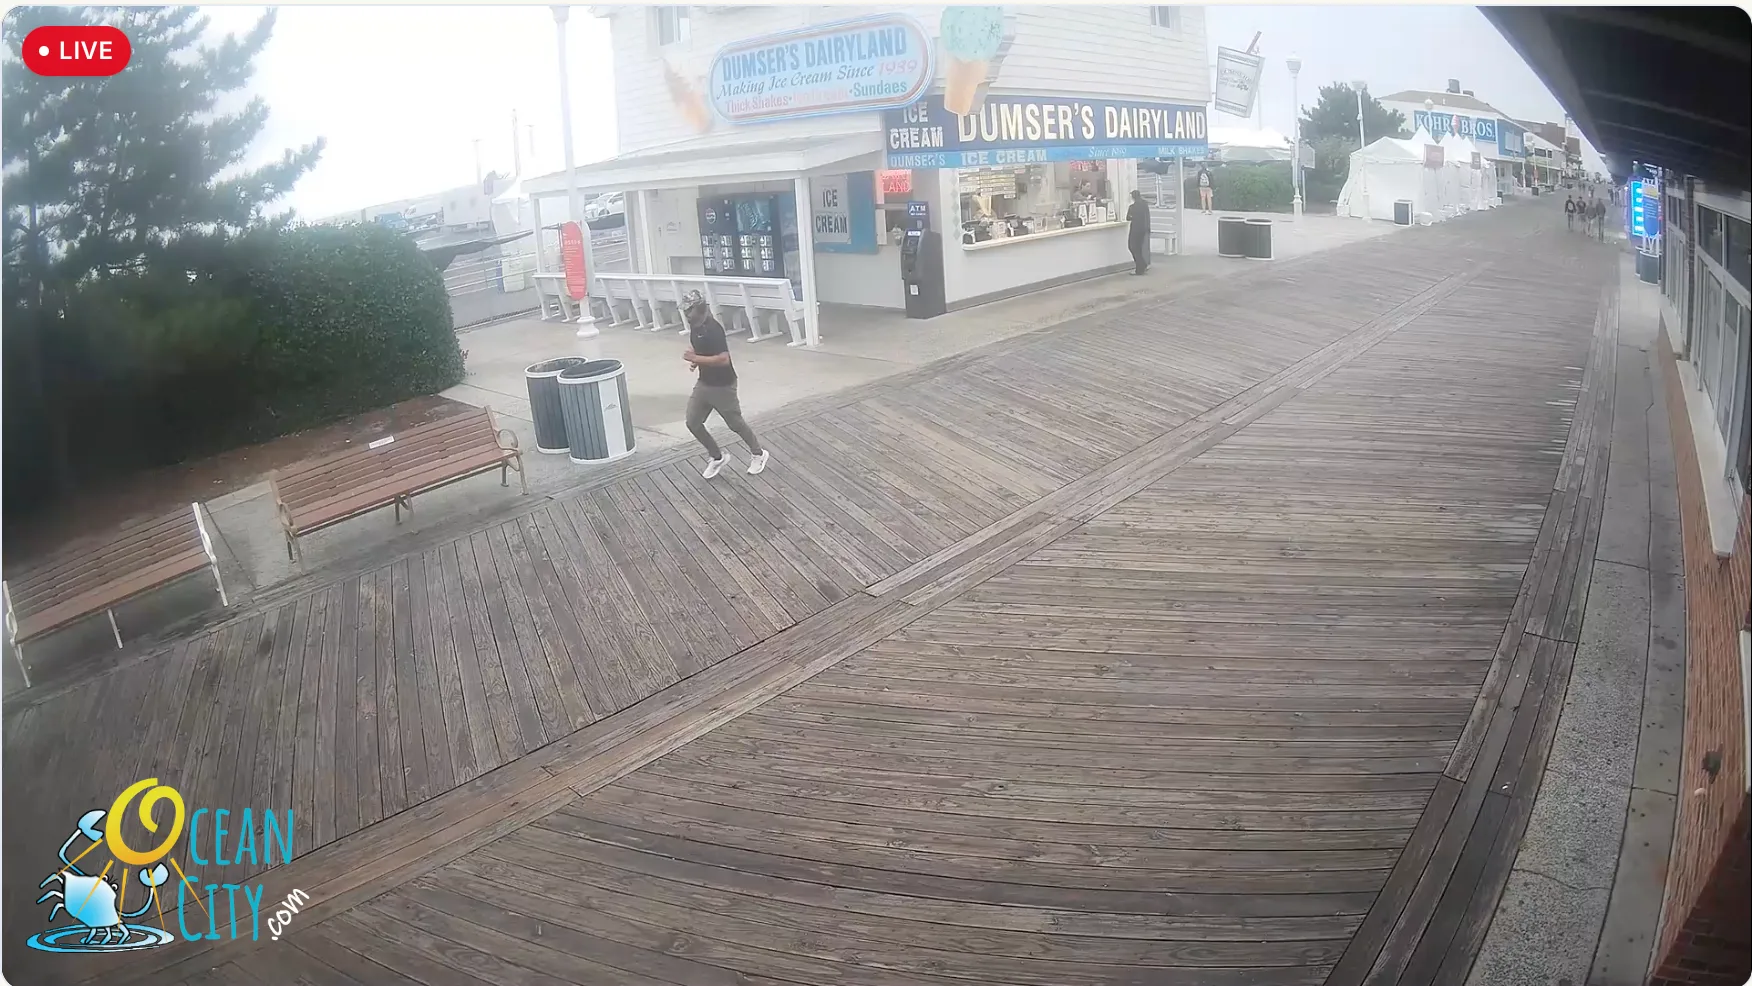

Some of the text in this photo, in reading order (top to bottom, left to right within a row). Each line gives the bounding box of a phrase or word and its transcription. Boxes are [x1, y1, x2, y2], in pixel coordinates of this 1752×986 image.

[722, 26, 907, 82] DUMSER'S DAIRYLAND
[716, 58, 919, 100] Making Ice Cream Since 1939
[725, 97, 752, 114] Thick
[751, 92, 789, 110] Shakes
[853, 80, 908, 98] Sundaes
[903, 101, 929, 124] ICE
[958, 103, 1205, 142] DUMSER'S DAIRYLAND
[1415, 114, 1451, 133] KOHR
[890, 126, 944, 149] CREAM
[890, 153, 946, 168] DUMSER'S
[961, 151, 989, 165] ICE
[995, 149, 1047, 164] CREAM
[1158, 146, 1175, 155] MILK
[1178, 146, 1205, 155] SHAKES
[822, 189, 838, 208] ICE
[815, 212, 848, 234] CREAM
